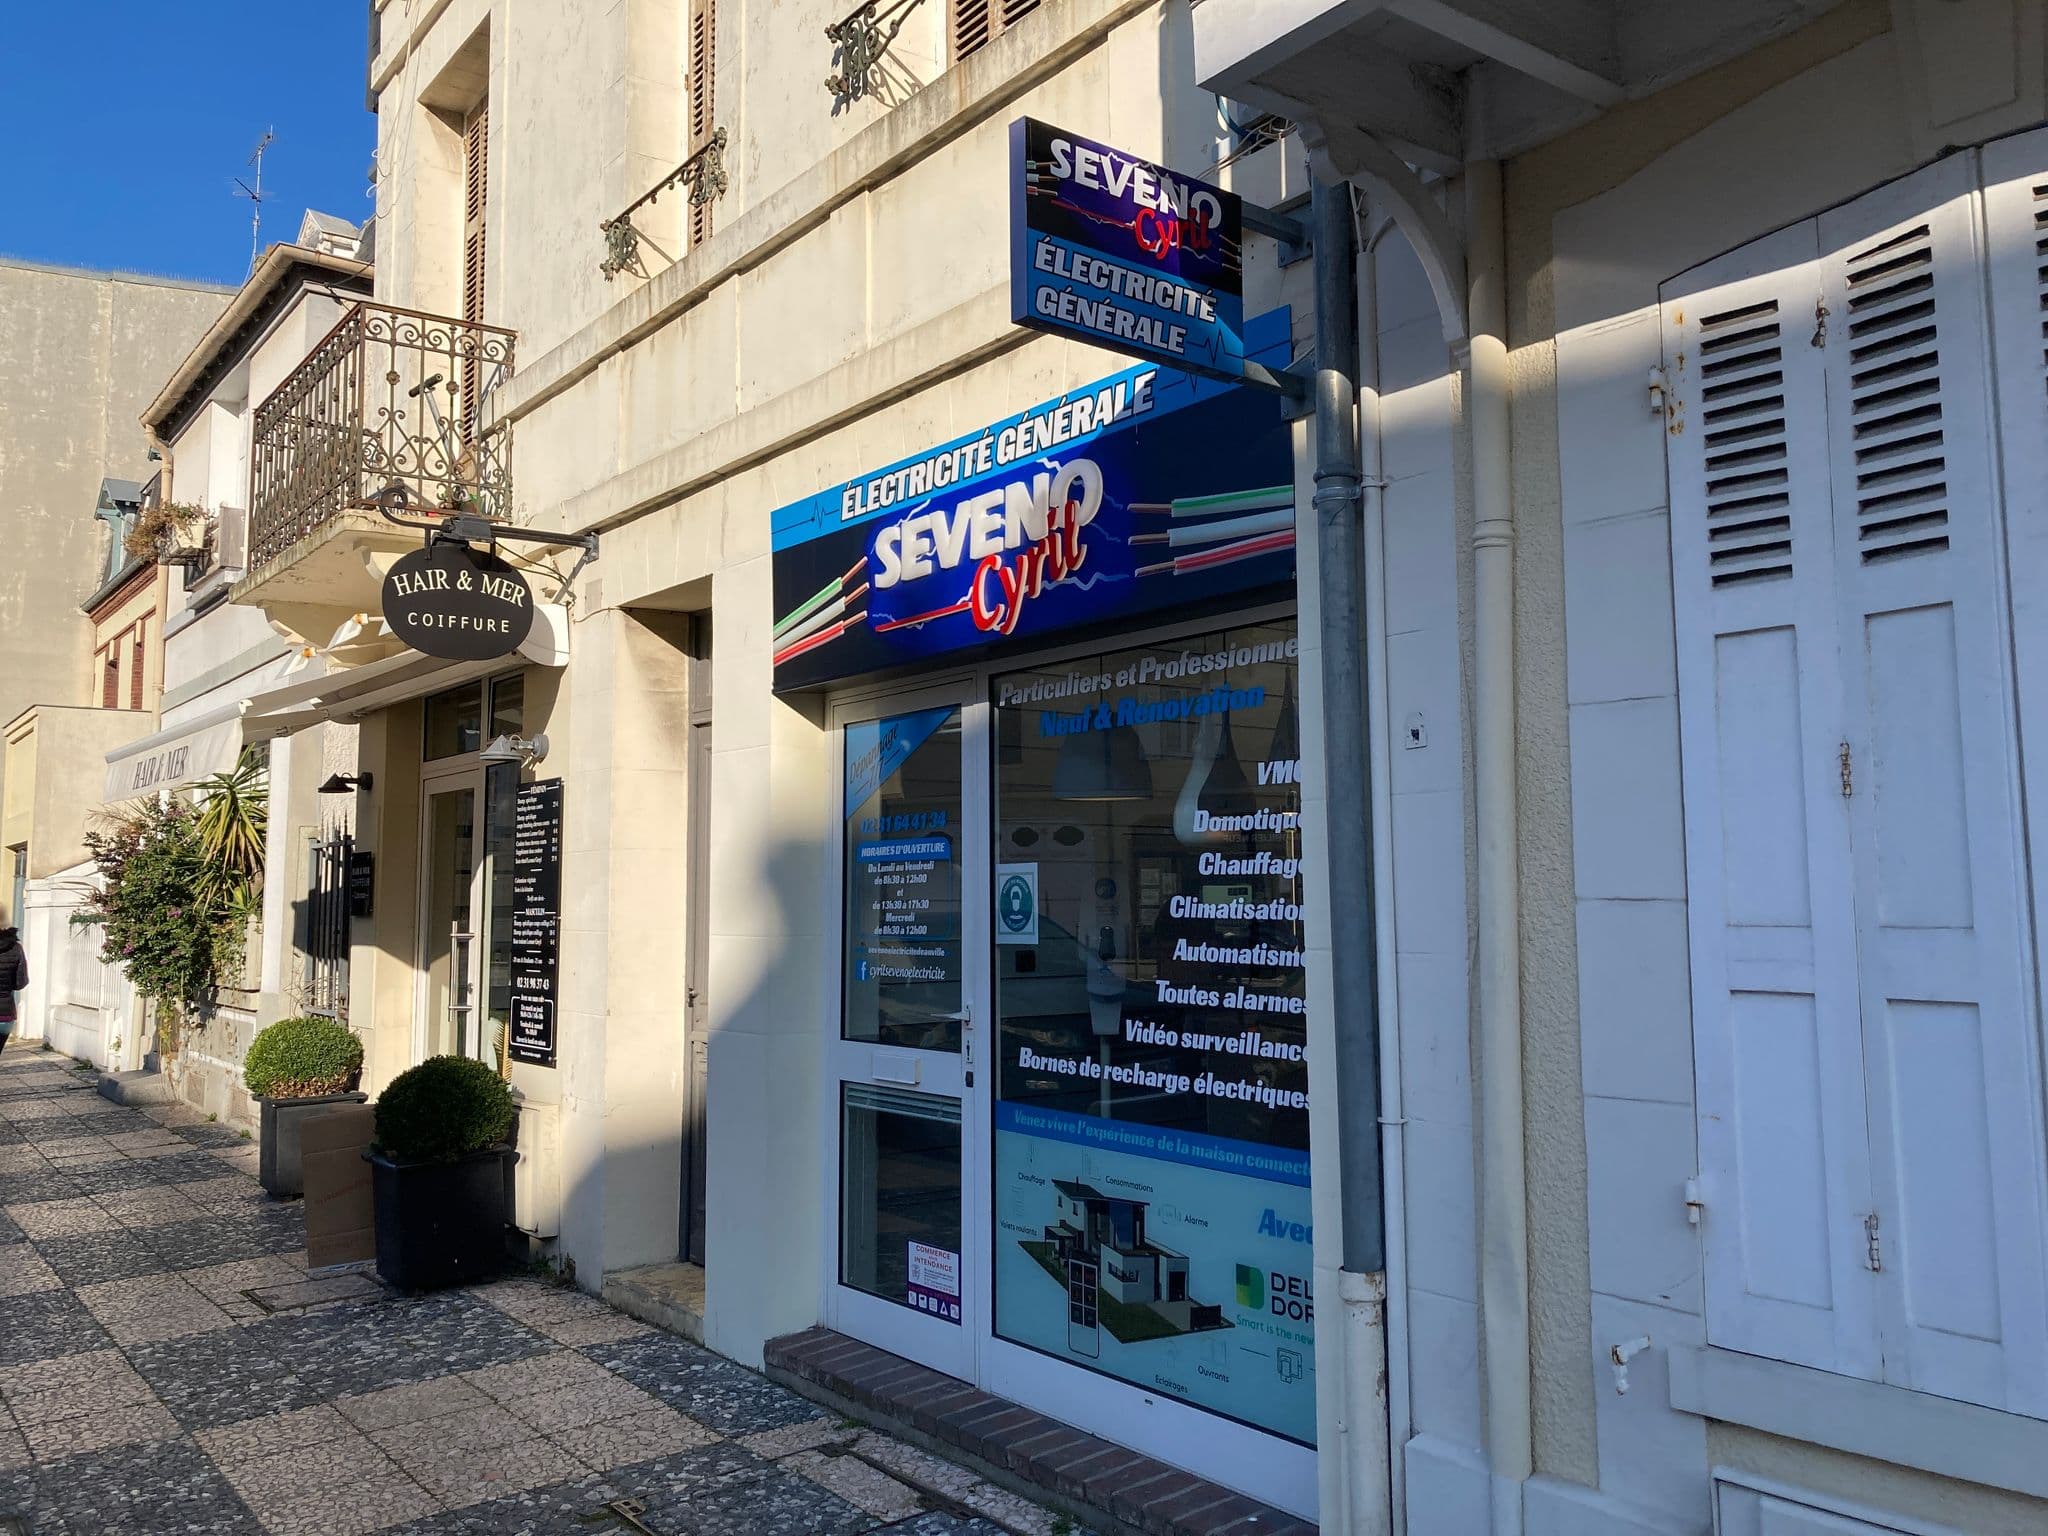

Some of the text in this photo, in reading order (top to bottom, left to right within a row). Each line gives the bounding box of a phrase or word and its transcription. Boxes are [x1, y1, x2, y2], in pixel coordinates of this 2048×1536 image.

[1050, 138, 1222, 229] SEVENO
[1135, 207, 1211, 260] Cyril
[1034, 237, 1217, 322] ÉLECTRICITÉ
[1035, 285, 1187, 354] GÉNÉRALE
[840, 370, 1158, 521] ÉLECTRICITÉ GÉNÉRALE
[873, 458, 1103, 589] SEVENO
[971, 499, 1087, 635] Cyril
[391, 569, 526, 608] HAIR & MER
[407, 612, 510, 633] COIFFURE
[1000, 671, 1112, 706] Particuliers
[1115, 663, 1137, 687] et
[861, 842, 945, 858] HORAIRES D'OUVERTURE
[877, 862, 896, 873] Lundi
[905, 861, 935, 872] Vendredi
[885, 912, 915, 922] Mercredi
[1156, 979, 1219, 1006] Toutes
[1126, 1018, 1177, 1047] Vidéo
[1019, 1046, 1076, 1076] Bornes
[1079, 1055, 1100, 1078] de
[1104, 1063, 1190, 1094] recharge
[1015, 1109, 1046, 1128] Venez
[1048, 1113, 1076, 1134] vivre
[1157, 1135, 1175, 1152] de
[1176, 1138, 1191, 1155] la
[1191, 1142, 1244, 1165] maison
[1246, 1149, 1312, 1177] connect
[1184, 1213, 1209, 1229] Alarme
[915, 1244, 951, 1260] COMMERCE
[1236, 1313, 1264, 1332] Smart
[1266, 1323, 1274, 1334] is
[1276, 1325, 1292, 1340] the
[1197, 1365, 1230, 1384] Ouvrants
